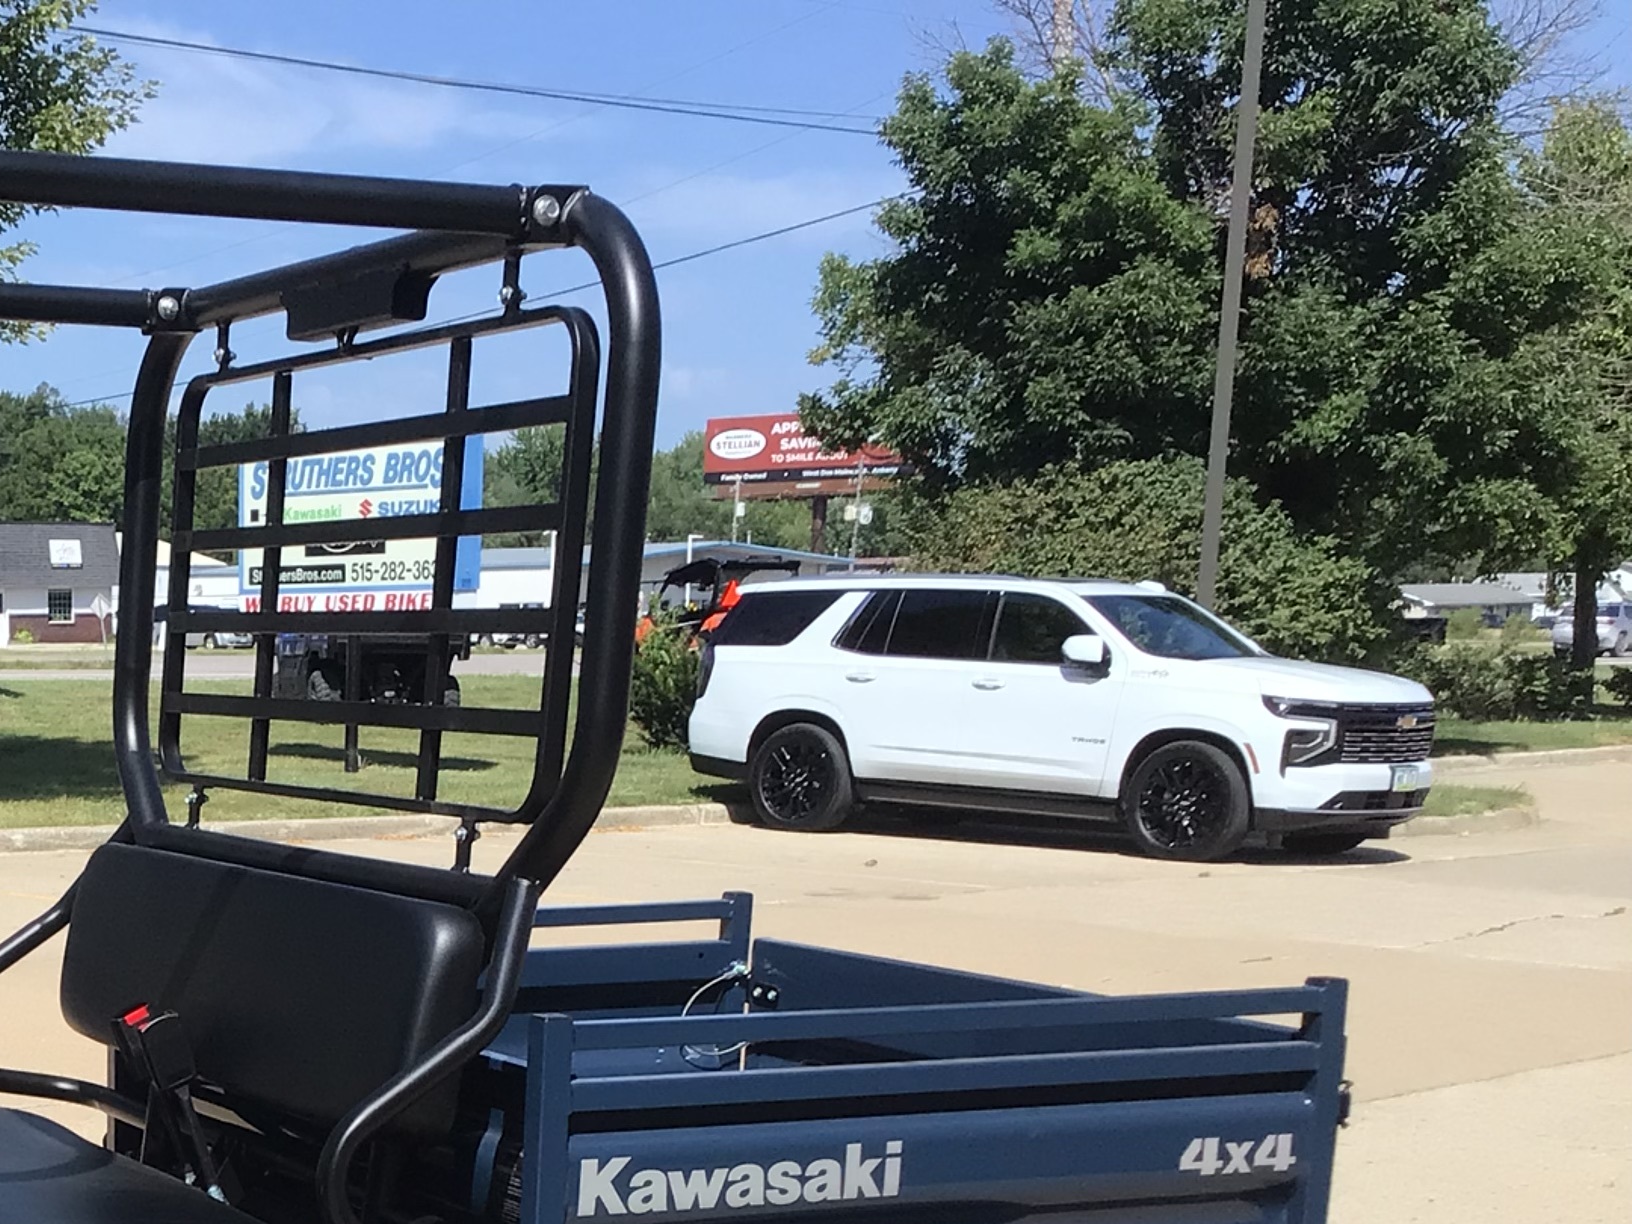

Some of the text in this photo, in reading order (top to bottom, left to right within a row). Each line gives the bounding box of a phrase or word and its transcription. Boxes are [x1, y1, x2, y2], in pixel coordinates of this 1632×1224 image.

[771, 454, 785, 463] TO
[250, 453, 376, 500] SUTHERS
[283, 504, 342, 521] Kawasaki
[378, 499, 440, 516] SUZUK
[280, 593, 316, 612] BUY
[325, 592, 376, 612] USED
[576, 1132, 1298, 1218] Kawasaki 4x4
